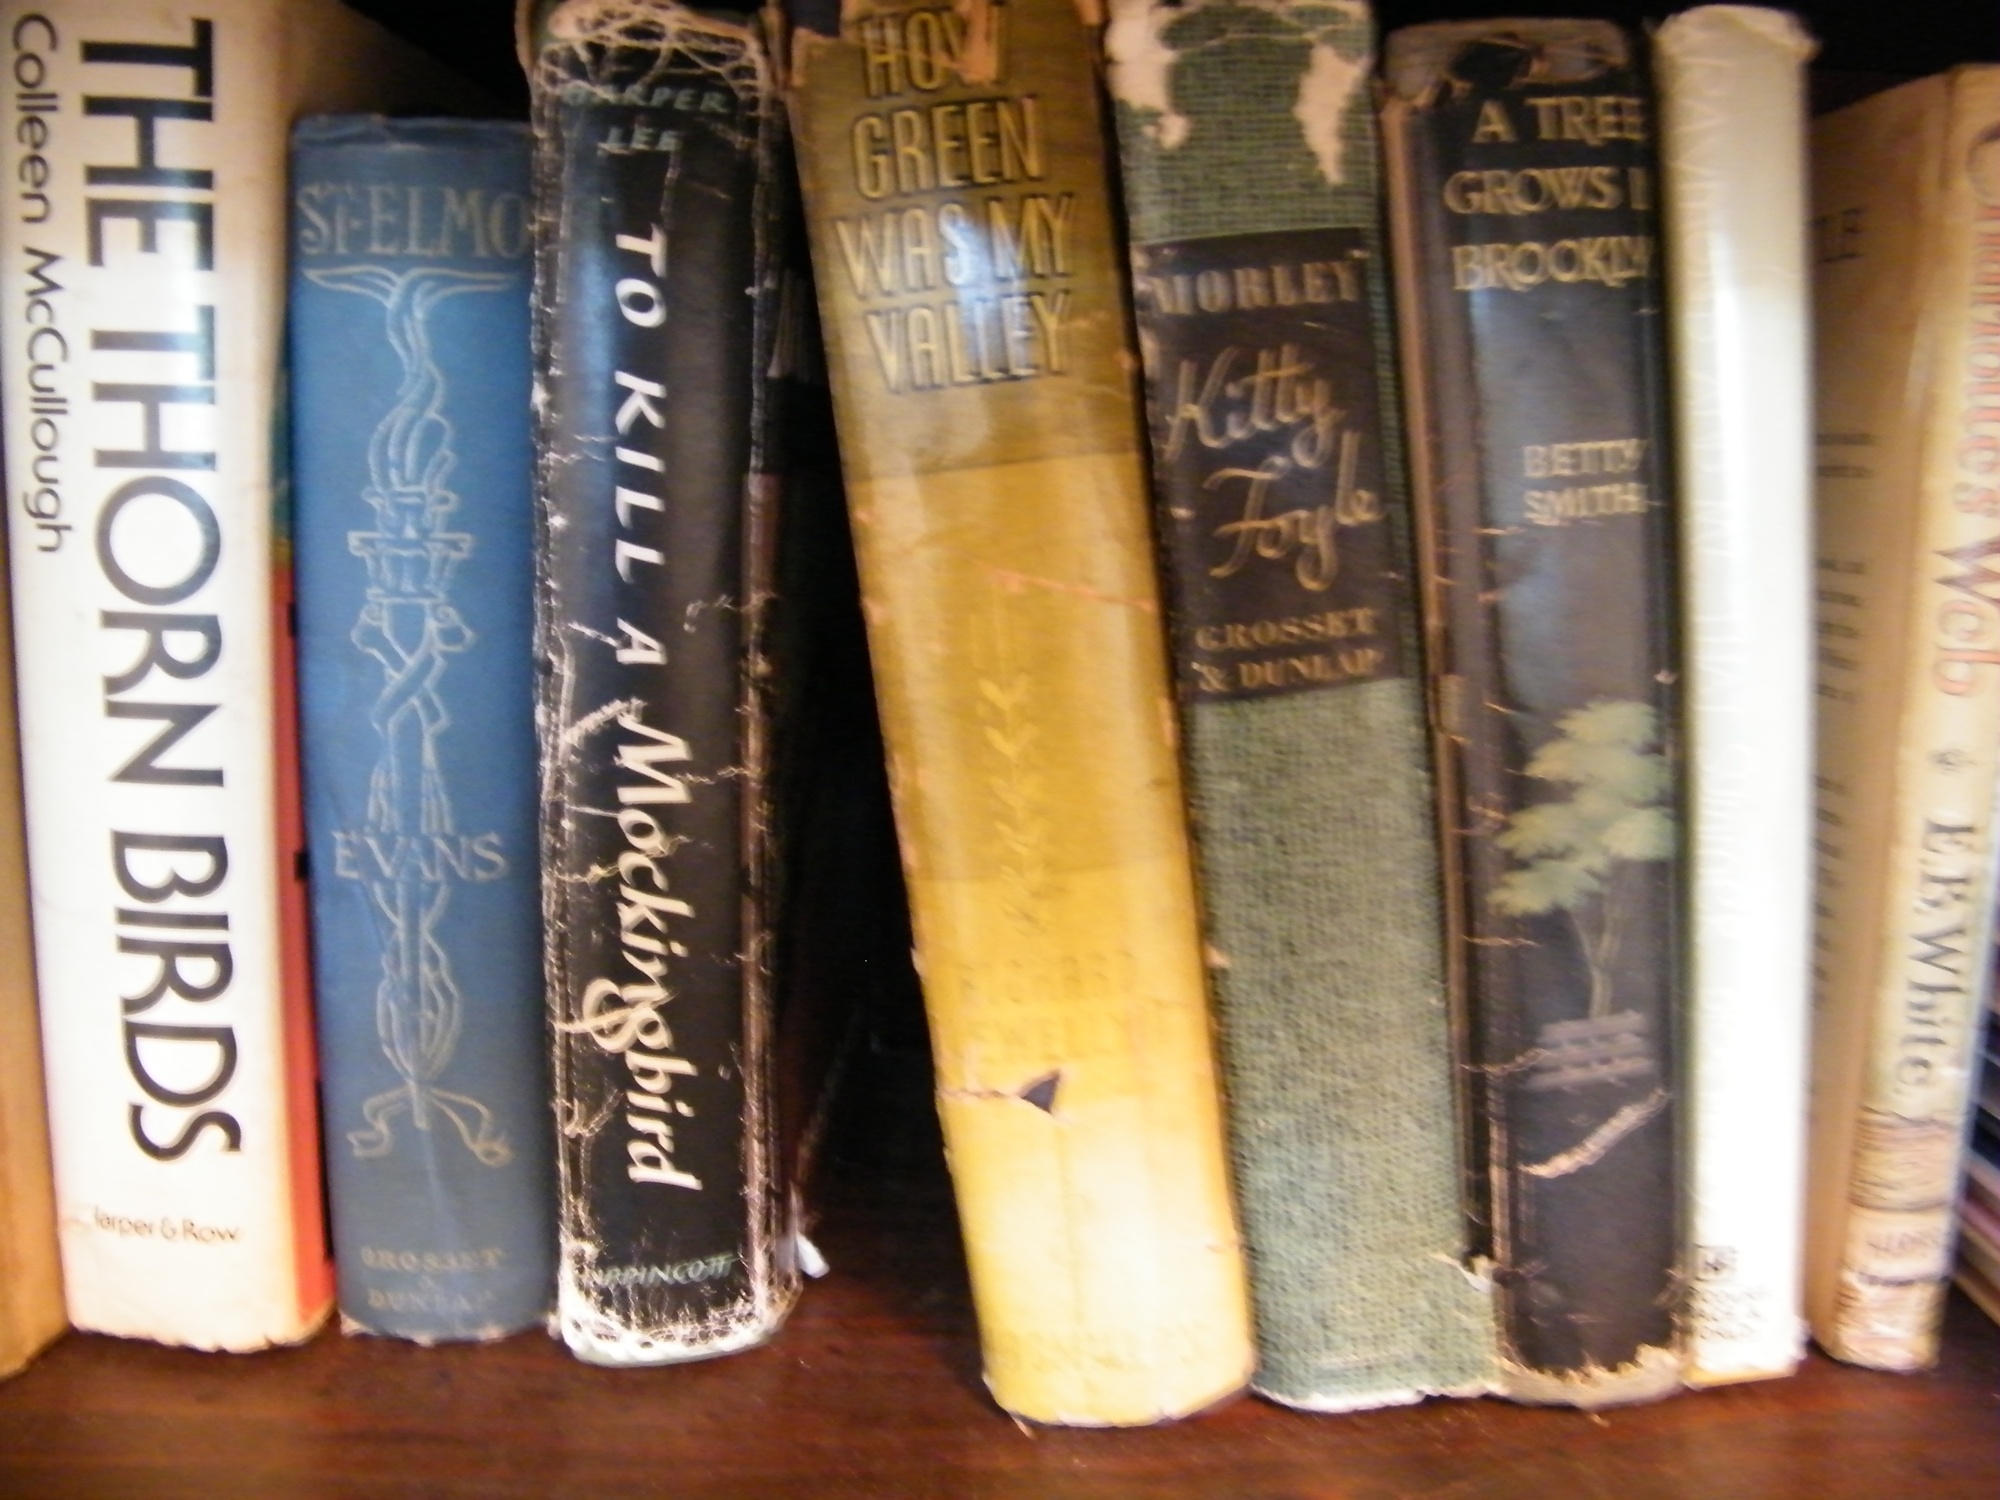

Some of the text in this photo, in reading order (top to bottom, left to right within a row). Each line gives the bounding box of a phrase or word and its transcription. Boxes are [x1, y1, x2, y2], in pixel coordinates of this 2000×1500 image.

[850, 94, 1048, 201] GREEN
[1470, 95, 1649, 147] A TREE
[1443, 165, 1623, 216] GROWS
[12, 13, 72, 554] Colleen McCullough
[834, 191, 1076, 303] WAS MY
[865, 289, 1075, 395] VALLEY
[1162, 342, 1346, 470] Kitty
[1523, 437, 1649, 480] BETTY
[1202, 430, 1387, 592] Foyle
[1523, 482, 1649, 520] SMITH
[80, 18, 242, 1161] THE THORN BIRDS
[1194, 607, 1377, 651] GROSSET
[578, 222, 702, 1191] TO KILL A Mockingbird
[332, 830, 506, 881] EVANS
[181, 1218, 240, 1243] Row
